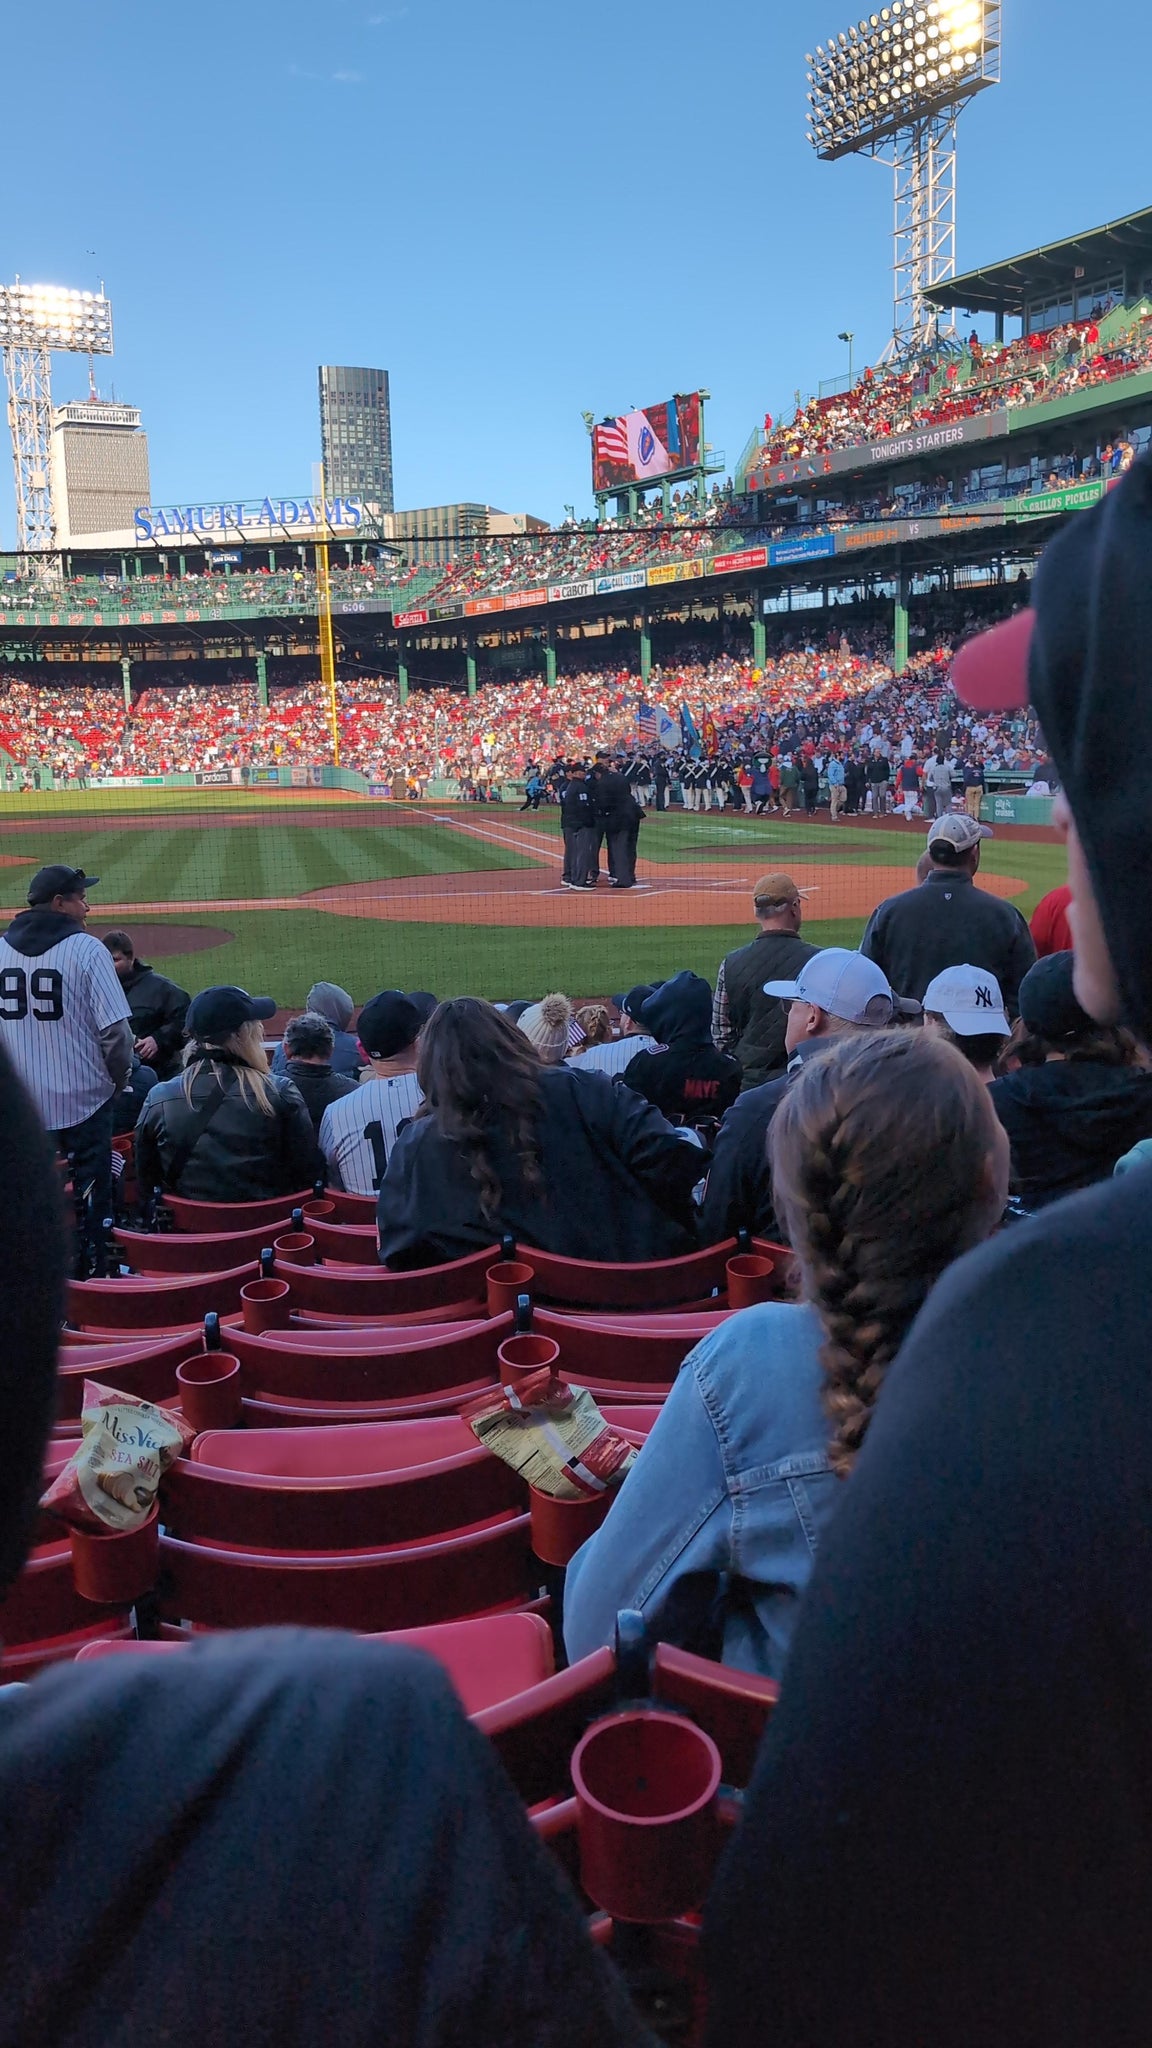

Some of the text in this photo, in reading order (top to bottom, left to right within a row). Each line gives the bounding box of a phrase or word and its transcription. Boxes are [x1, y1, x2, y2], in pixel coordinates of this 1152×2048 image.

[870, 427, 964, 459] TONIGHT'S STARTERS
[1029, 488, 1100, 512] GRILLO'S PICKLES
[133, 495, 362, 541] SAMUEL ADAMS
[909, 523, 919, 535] VS
[68, 613, 84, 626] 27
[342, 602, 365, 612] 6:06
[0, 967, 64, 1021] 99
[974, 985, 993, 1008] NY
[102, 1410, 135, 1446] Miss
[110, 1448, 132, 1466] SEA
[137, 1455, 160, 1478] SALT
